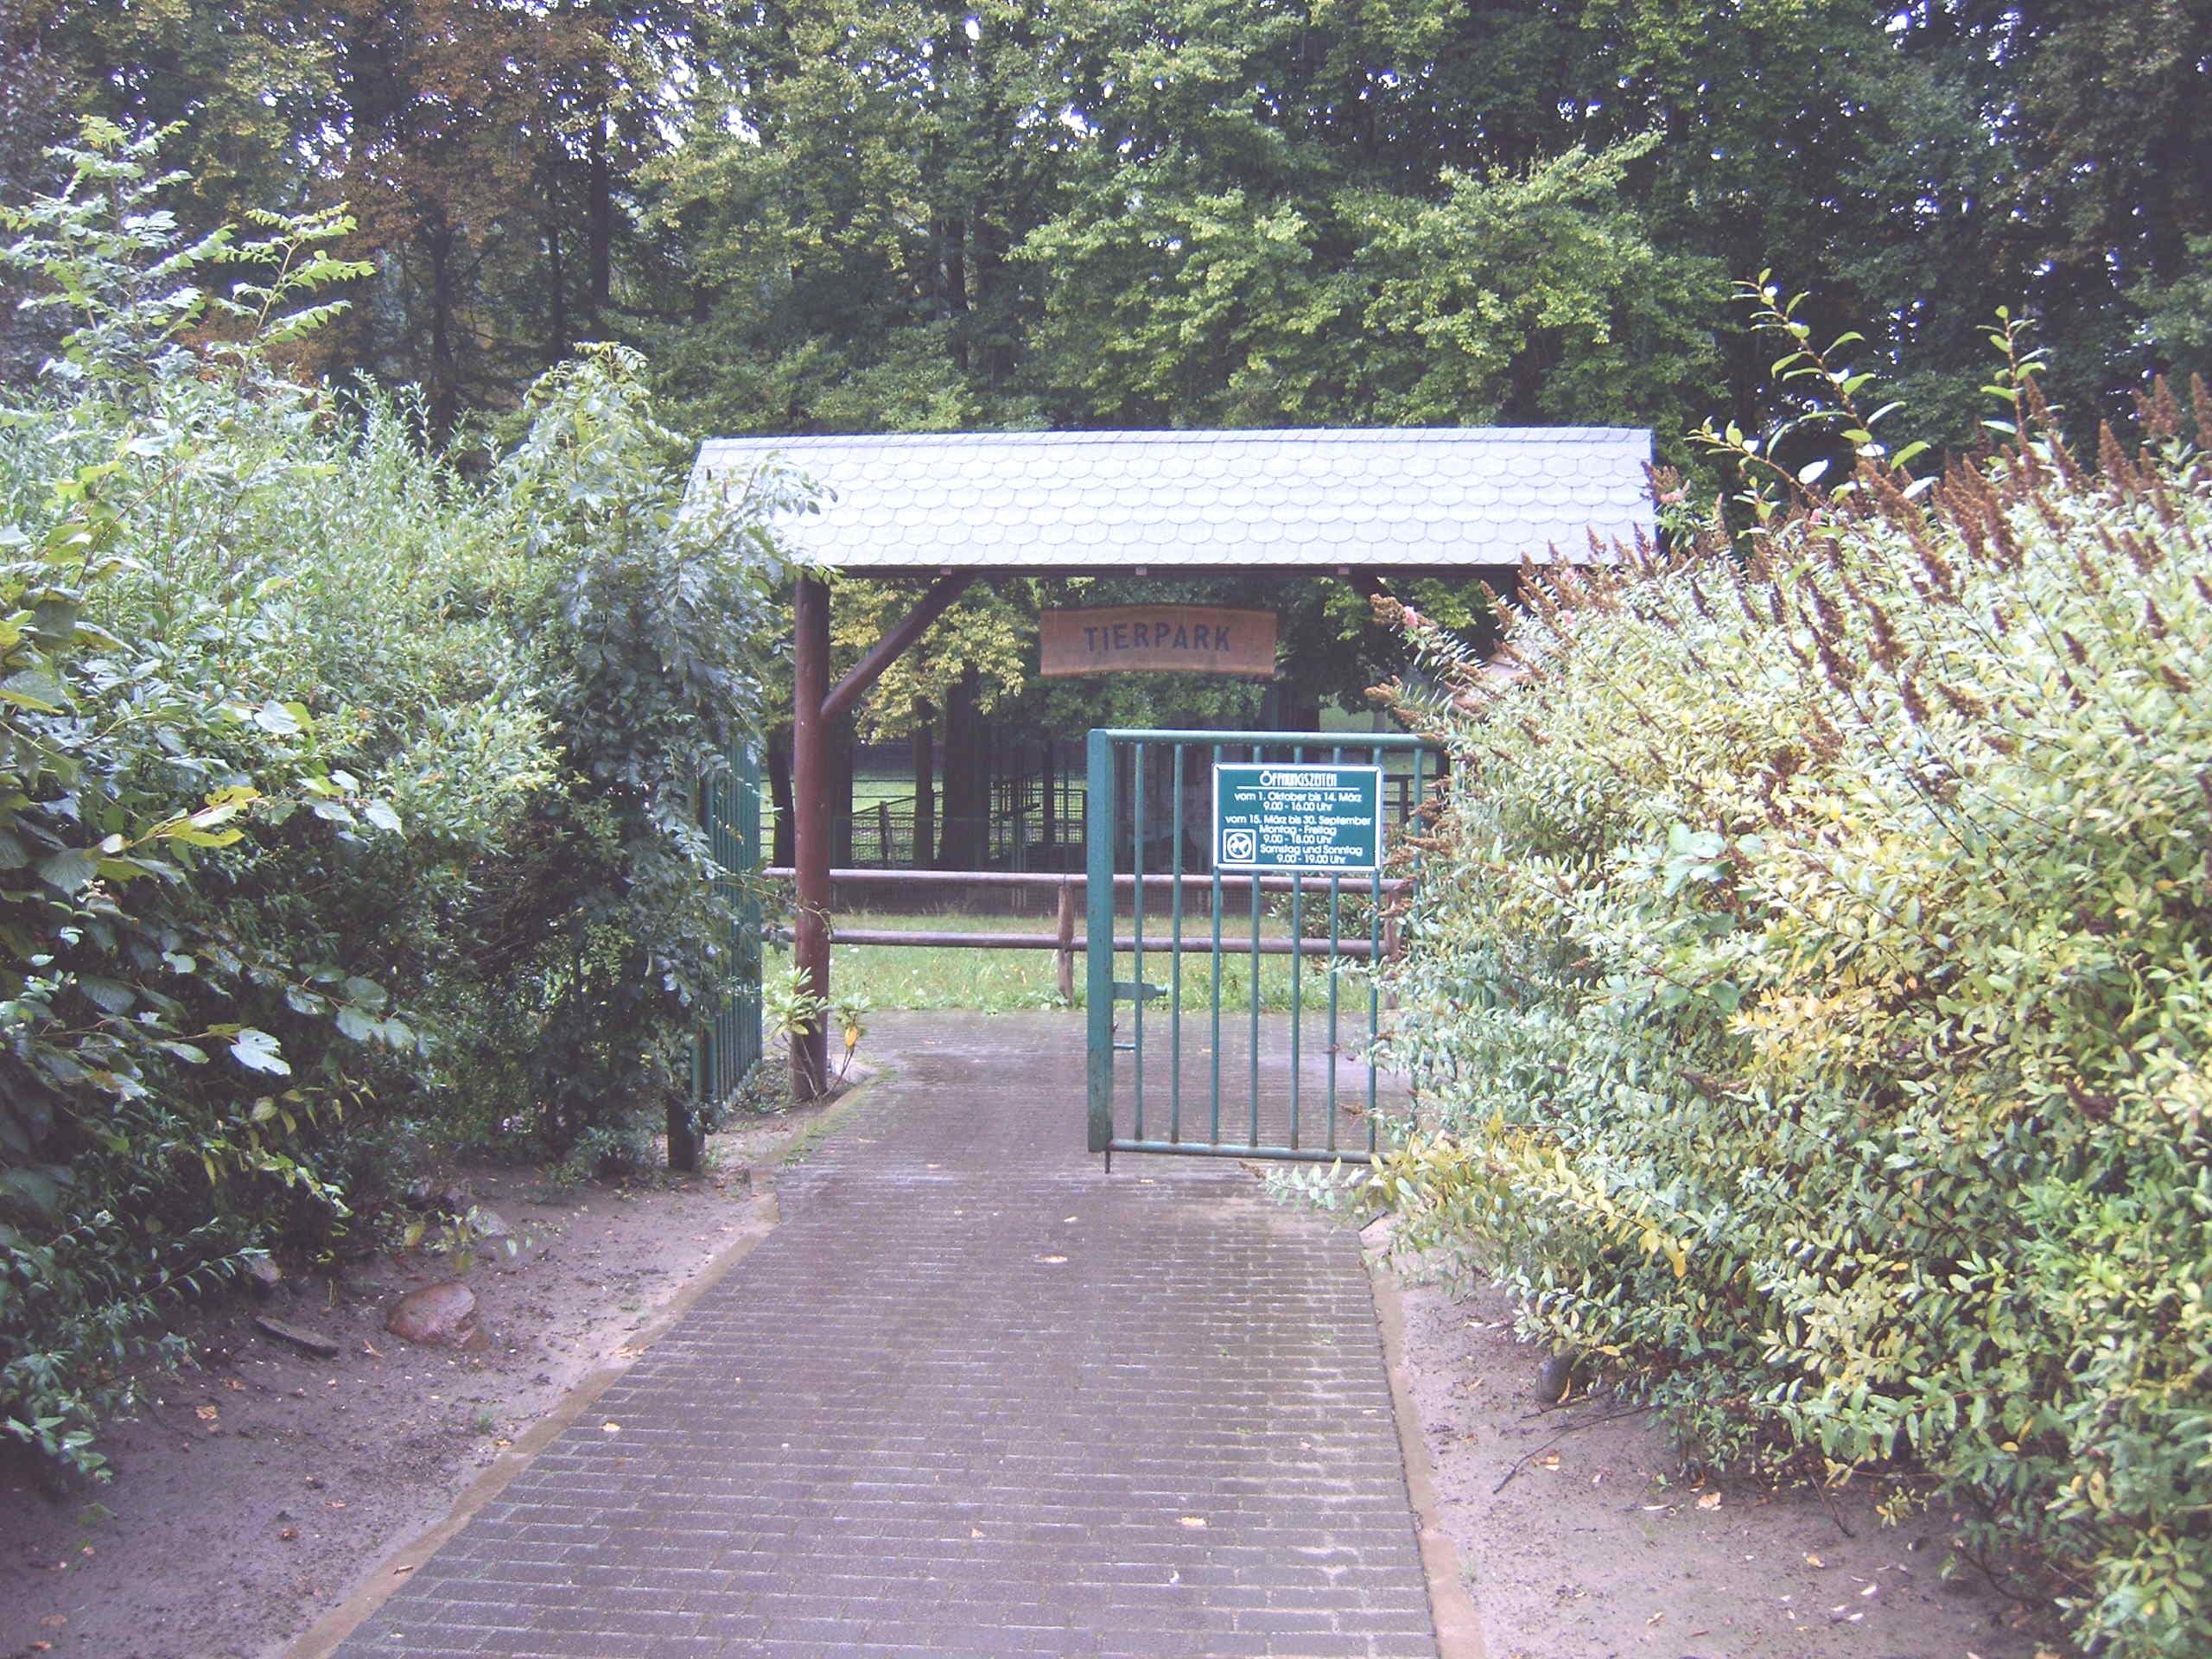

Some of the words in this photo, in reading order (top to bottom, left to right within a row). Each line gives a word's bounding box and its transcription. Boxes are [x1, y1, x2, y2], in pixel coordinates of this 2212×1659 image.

[1084, 622, 1231, 652] TIERPARK
[1268, 792, 1306, 801] Oktober
[1325, 793, 1336, 802] 14.
[1263, 802, 1282, 810] 9.00
[1292, 802, 1314, 811] 16.00
[1317, 803, 1332, 811] Uhr
[1249, 815, 1262, 823] 15.
[1264, 815, 1287, 823] März
[1289, 815, 1301, 824] bis
[1303, 816, 1316, 824] 30.
[1319, 816, 1371, 826] September
[1260, 825, 1296, 835] Montag
[1305, 826, 1336, 836] Freitag
[1263, 835, 1282, 843] 9.00
[1292, 835, 1314, 843] 18.00
[1260, 844, 1300, 855] Samstag
[1303, 845, 1320, 854] und
[1323, 845, 1363, 856] Sonntag
[1277, 854, 1296, 862] 9.00
[1305, 855, 1328, 863] 19.00
